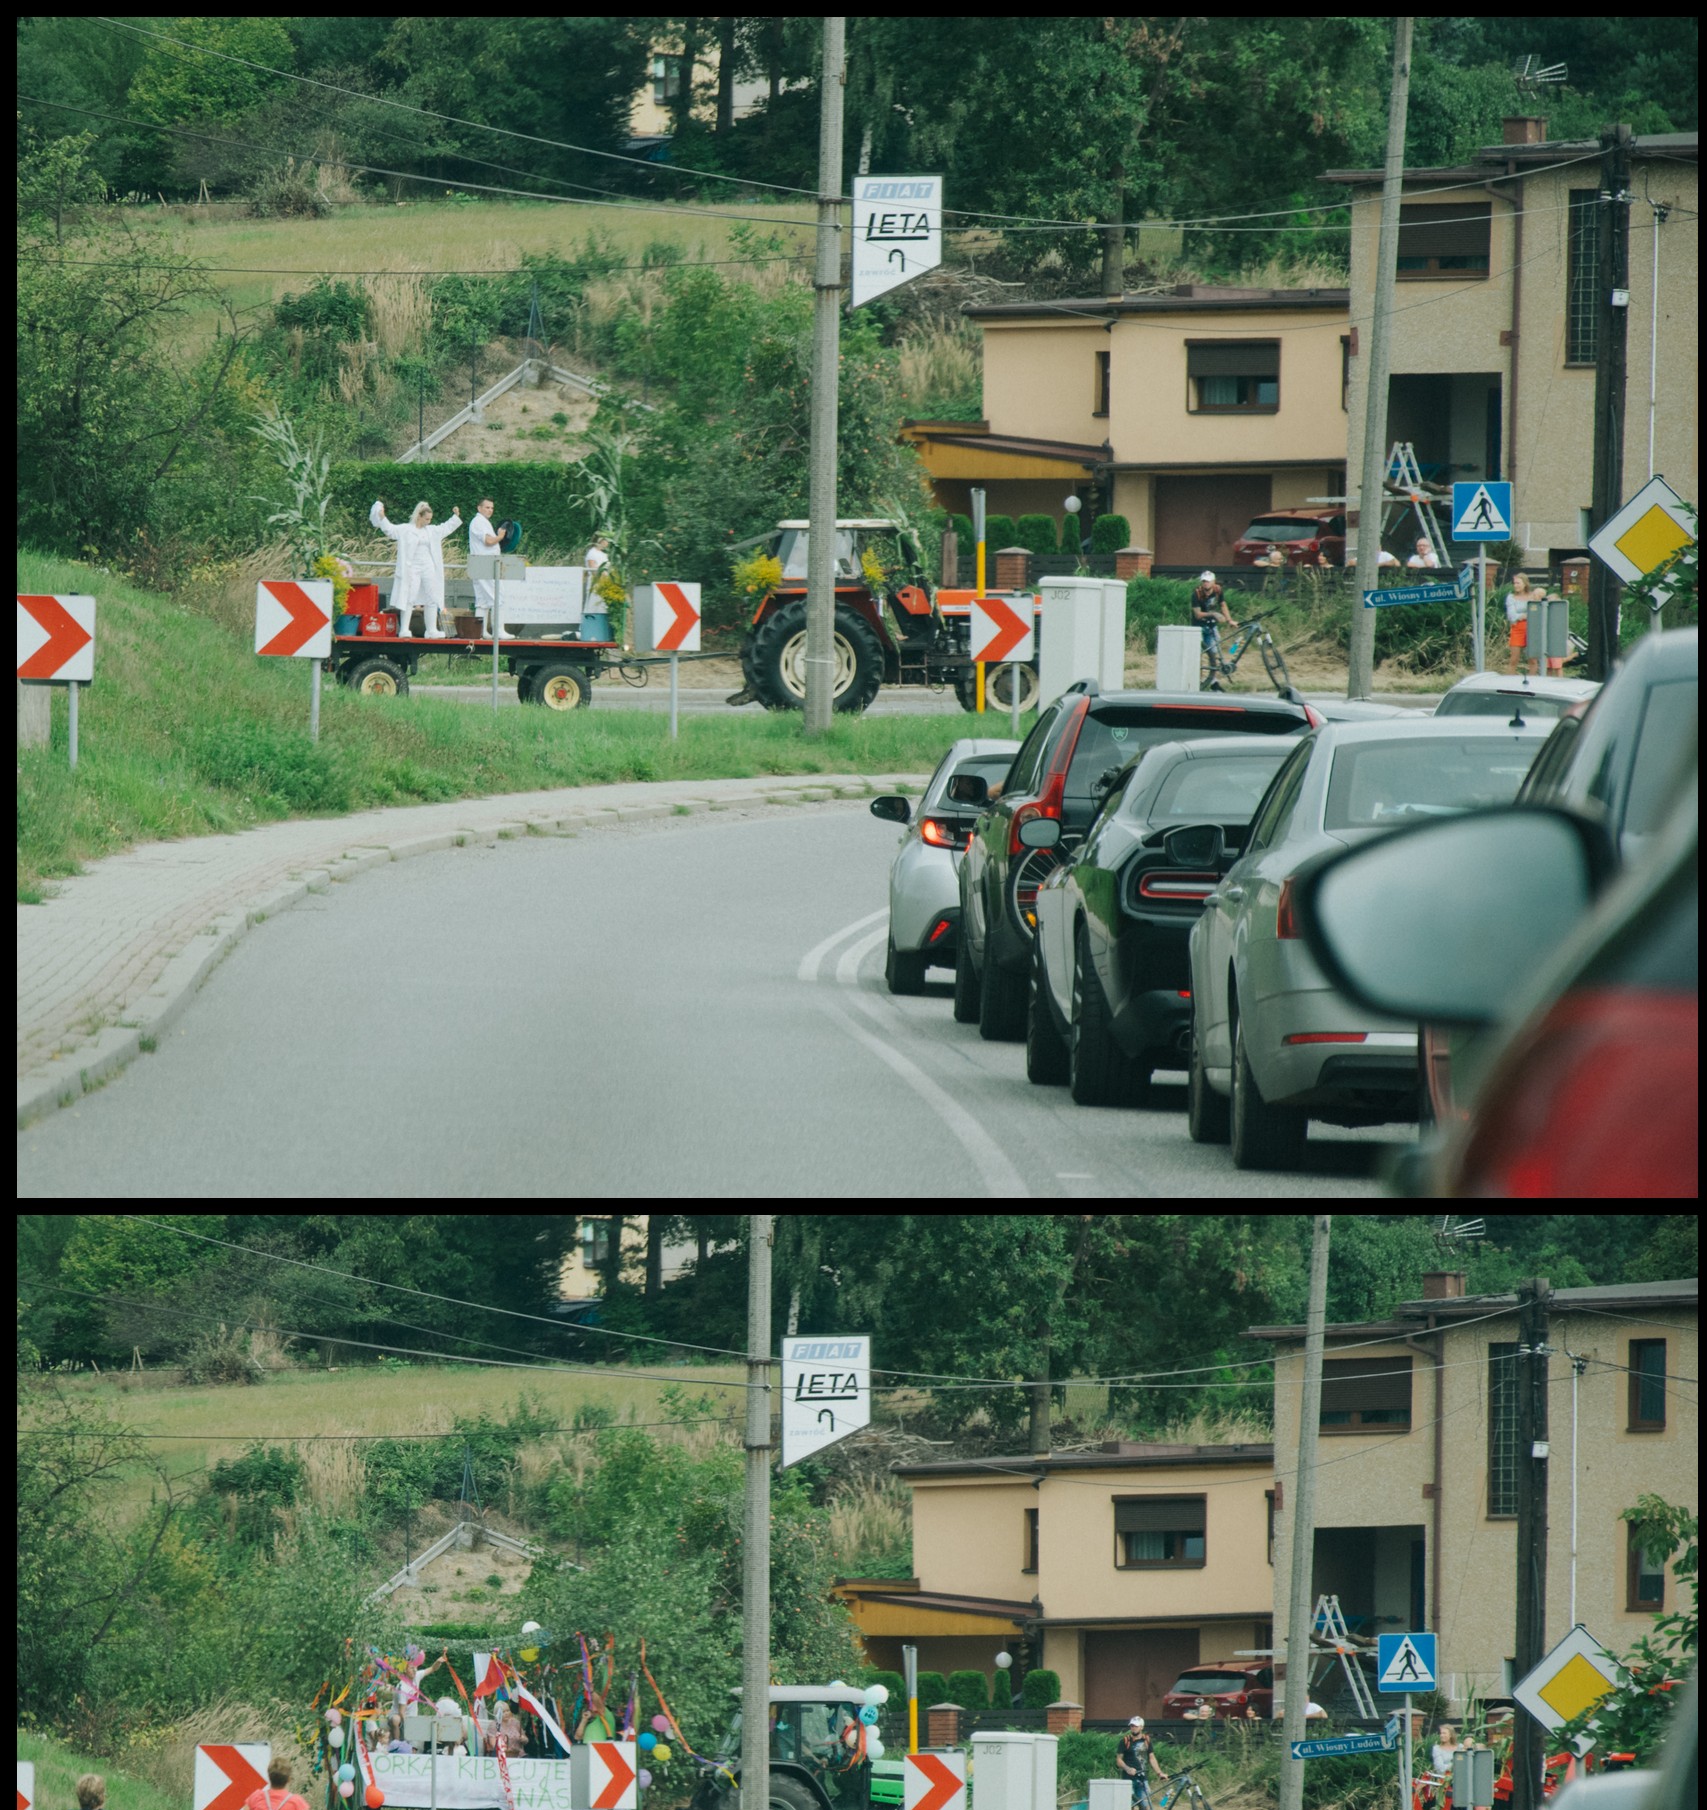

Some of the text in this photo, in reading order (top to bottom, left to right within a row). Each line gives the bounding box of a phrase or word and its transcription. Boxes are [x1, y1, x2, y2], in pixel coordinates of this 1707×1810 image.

[864, 184, 933, 198] FIAT
[865, 213, 930, 241] LETA
[1374, 588, 1454, 603] ul. Wiosny Ludów
[792, 1343, 862, 1359] FIAT
[795, 1373, 859, 1401] LETA
[1302, 1737, 1381, 1754] ul. Wiosny Ludów
[458, 1756, 568, 1791] KIBCUJE
